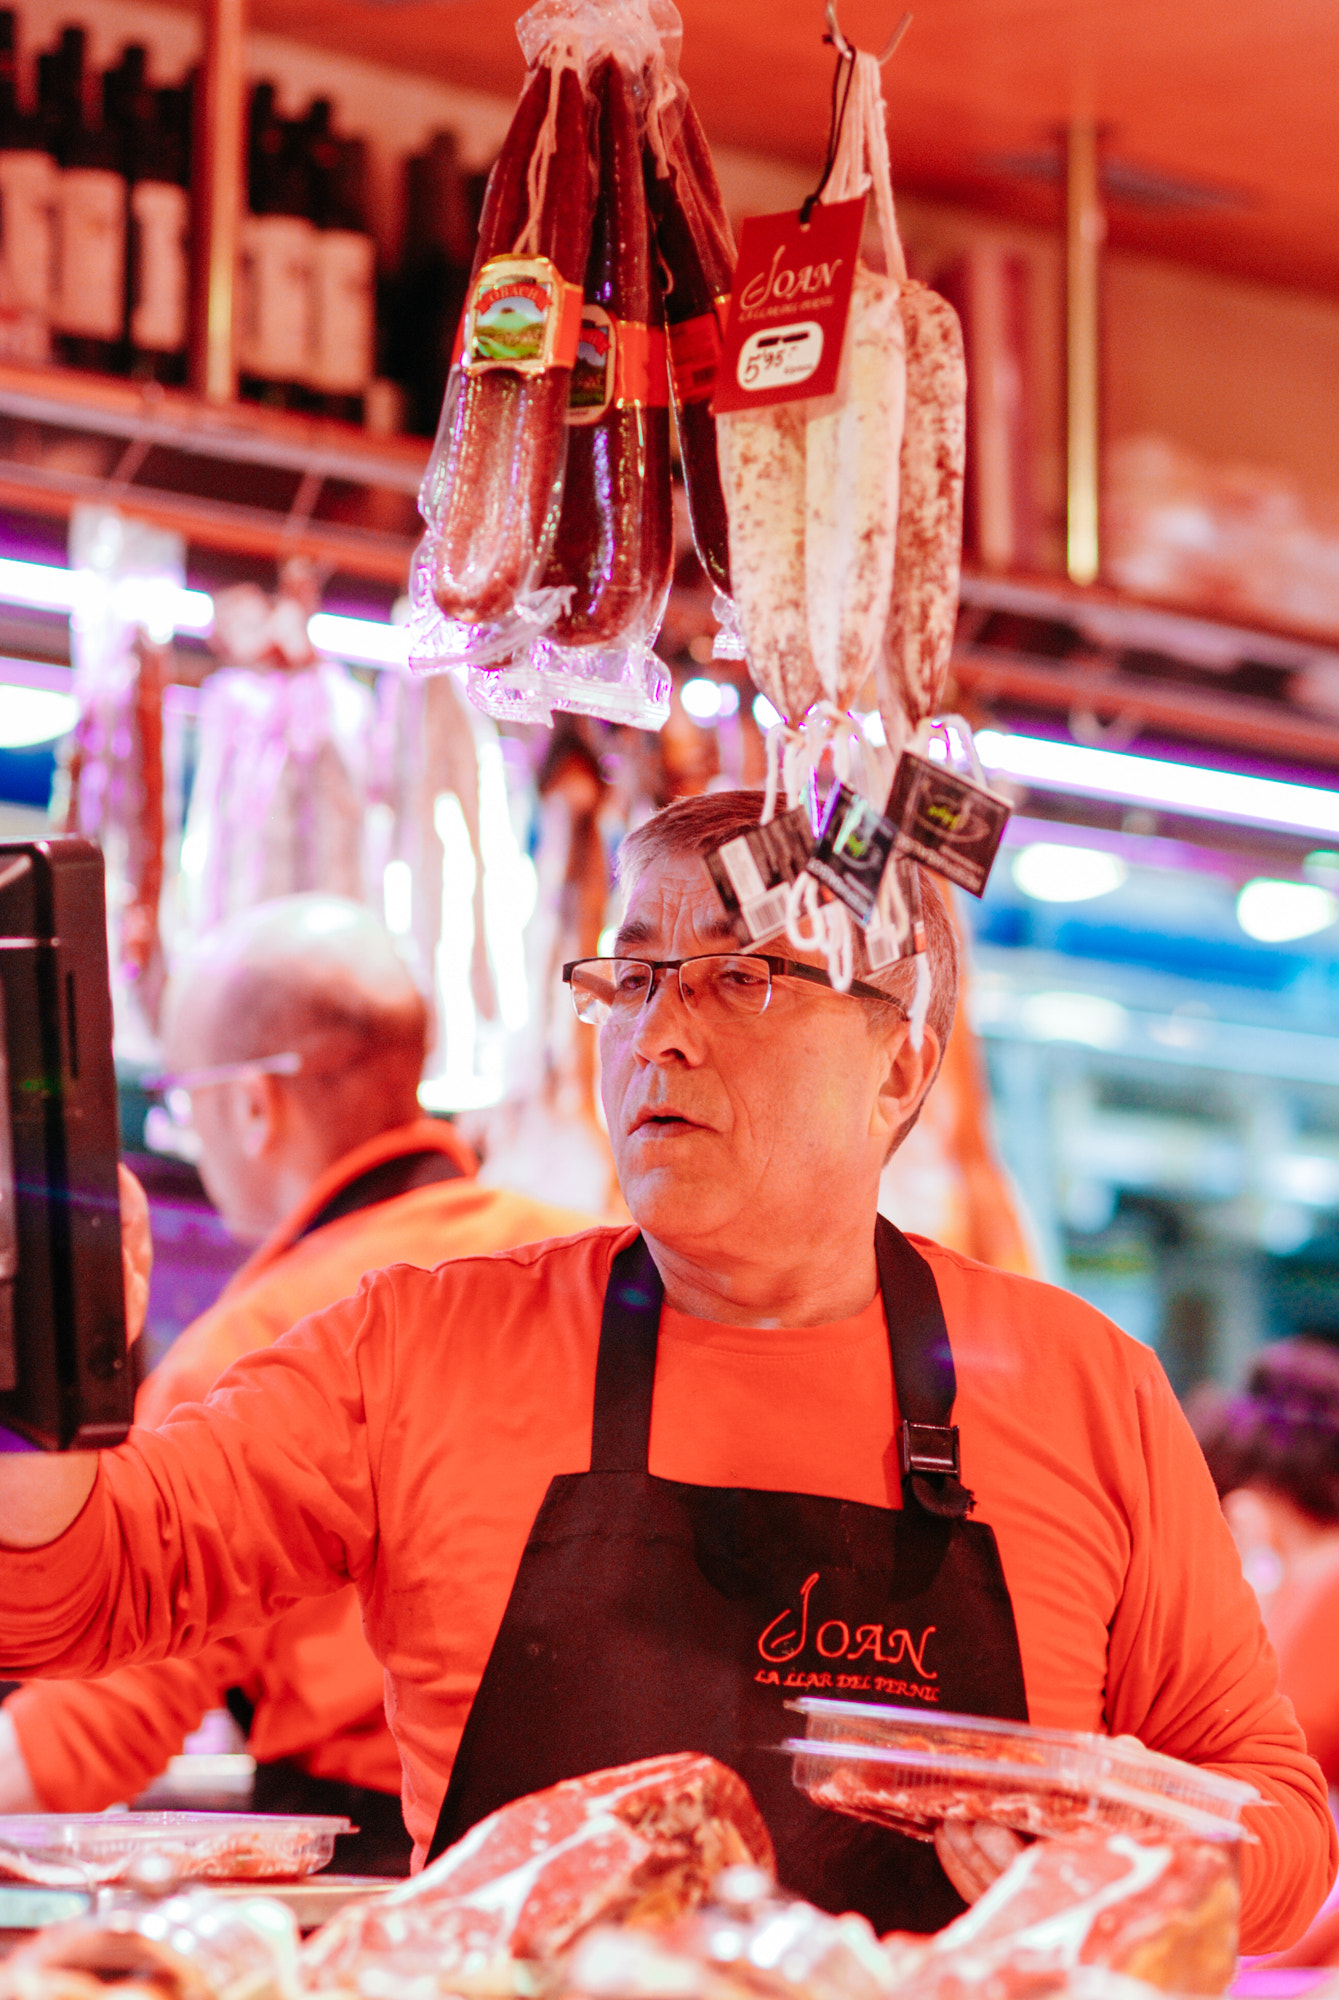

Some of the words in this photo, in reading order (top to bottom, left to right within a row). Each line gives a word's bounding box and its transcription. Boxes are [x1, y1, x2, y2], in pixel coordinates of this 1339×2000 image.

[740, 245, 843, 310] JOAN
[758, 1572, 937, 1680] JOAN
[754, 1669, 780, 1686] LA
[783, 1671, 834, 1687] LLAR
[836, 1672, 872, 1690] DEL
[874, 1675, 940, 1702] PERNIL
